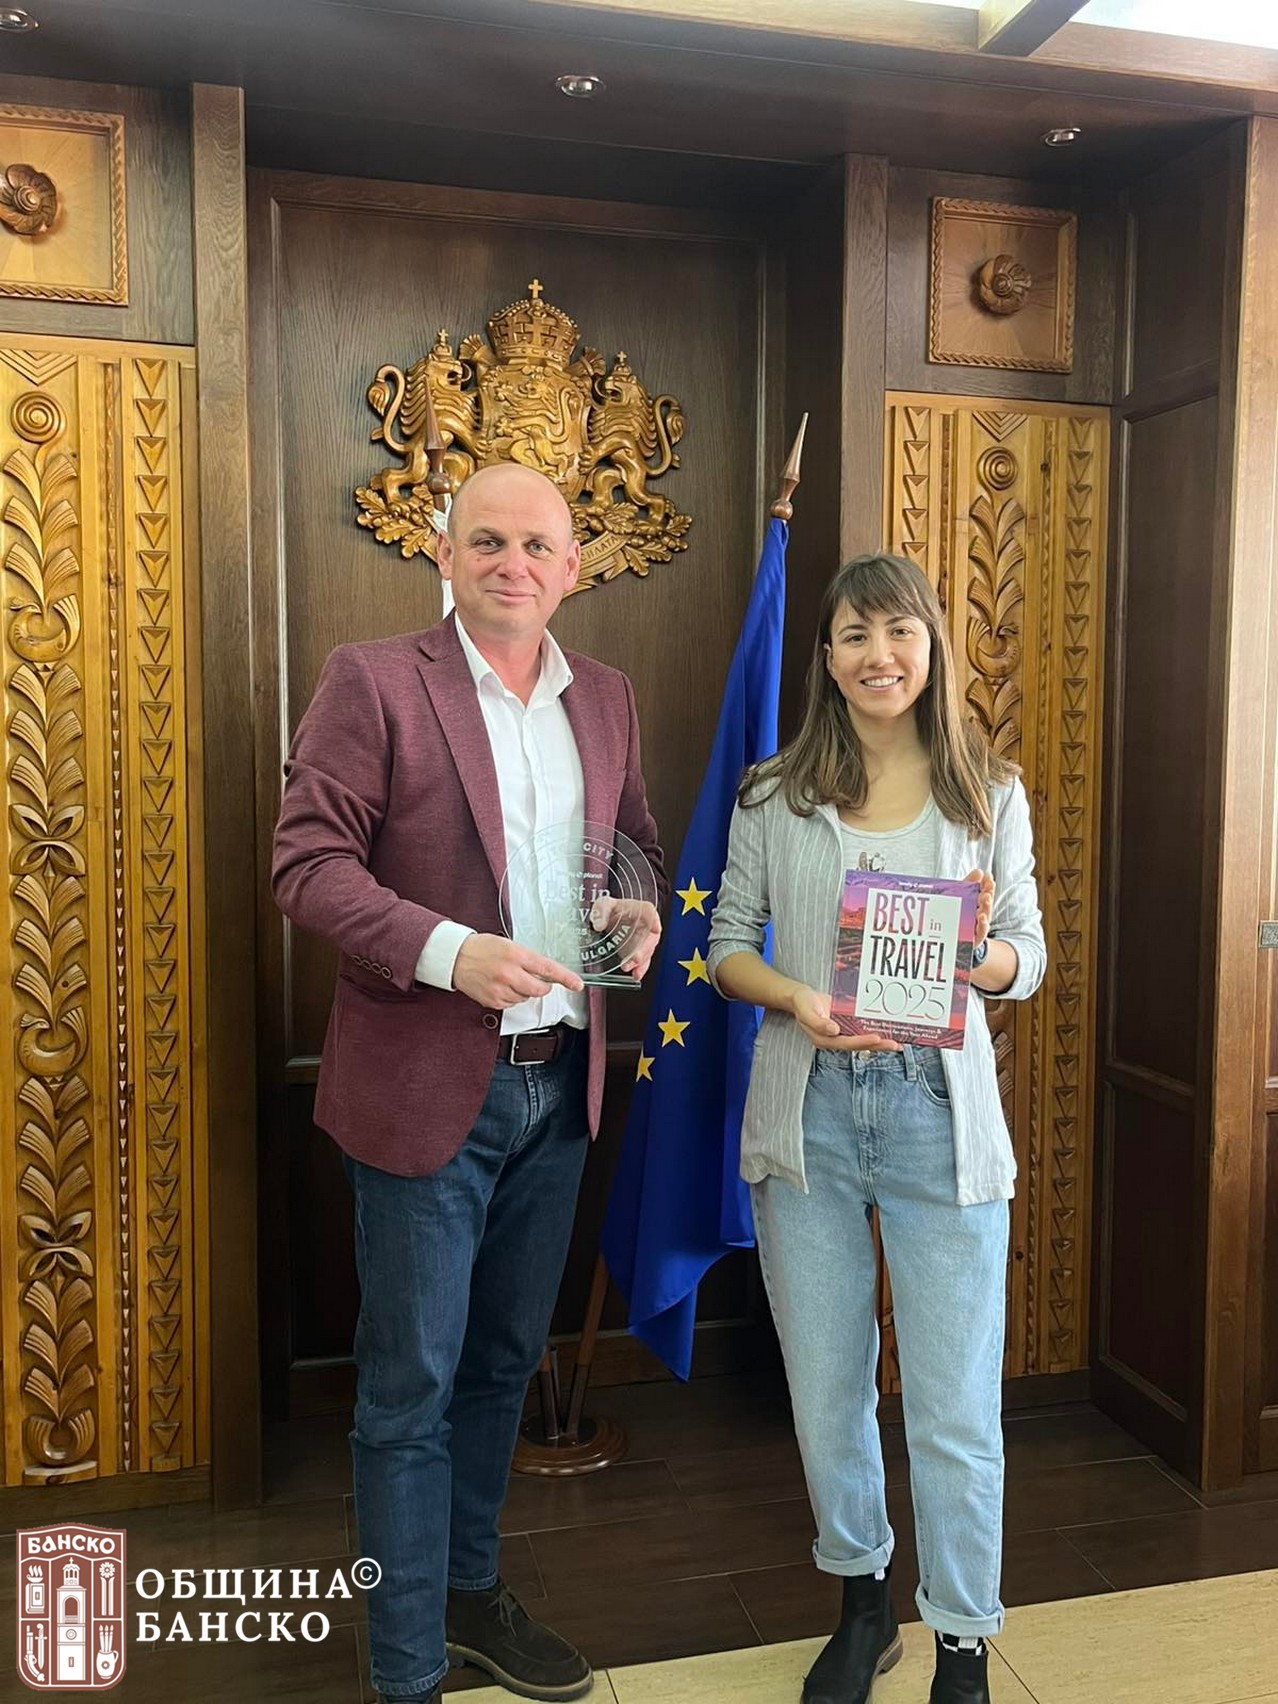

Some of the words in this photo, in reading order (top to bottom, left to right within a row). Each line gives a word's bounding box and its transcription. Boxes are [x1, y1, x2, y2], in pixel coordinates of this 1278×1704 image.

[583, 842, 613, 860] CITY
[873, 893, 929, 936] BEST
[930, 918, 942, 932] in
[576, 924, 631, 961] ULGARIA
[870, 935, 947, 983] TRAVEL
[863, 979, 945, 1020] 2025
